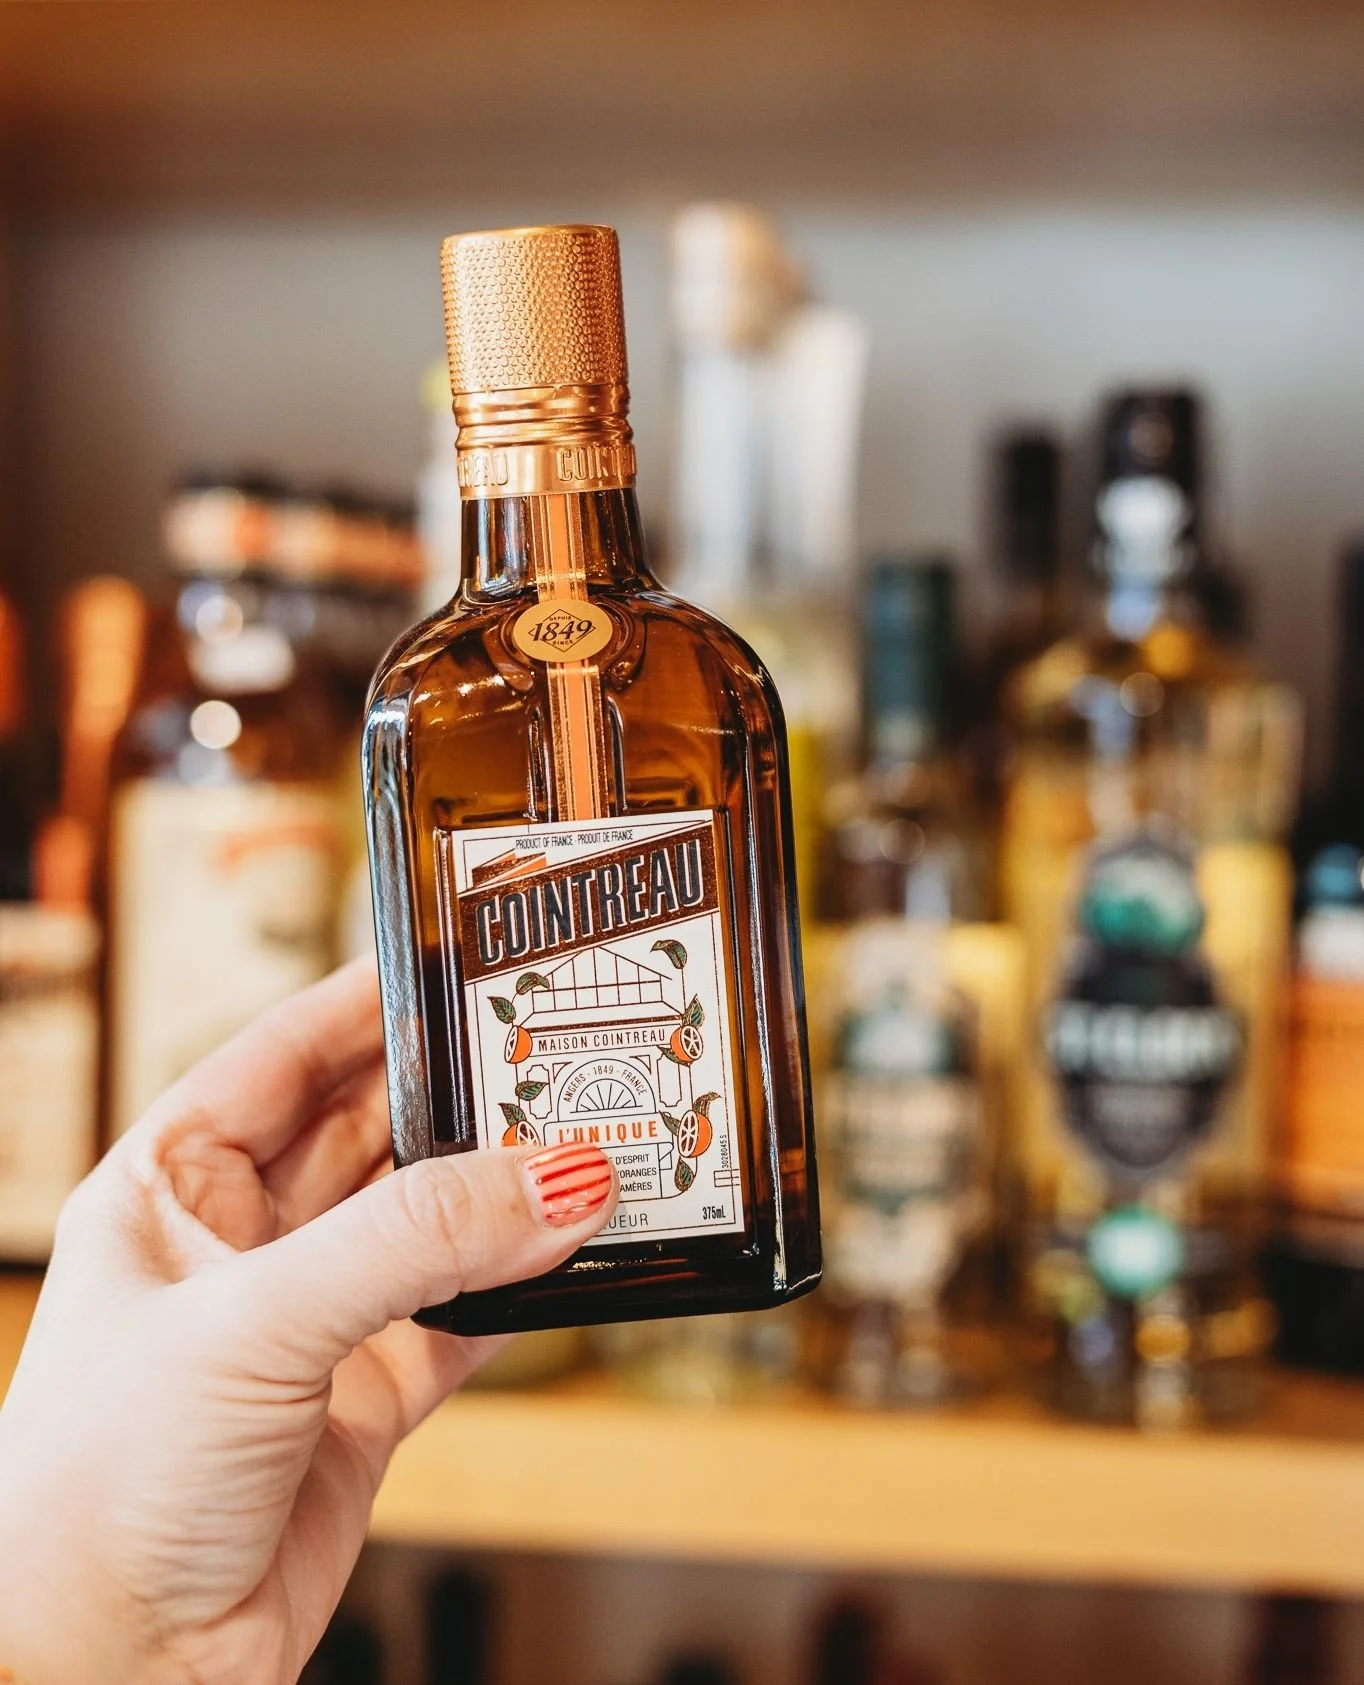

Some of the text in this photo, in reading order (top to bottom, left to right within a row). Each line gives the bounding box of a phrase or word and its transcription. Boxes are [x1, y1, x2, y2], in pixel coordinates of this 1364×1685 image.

[532, 619, 593, 641] 1849
[515, 829, 633, 850] PRODUCT OF FRANCE PRODUIT DE FRANCE
[476, 838, 704, 966] COINTREAU
[538, 1029, 666, 1052] MAISON COINTREAU
[563, 1064, 648, 1103] ANGERS 1849 FRANCE
[615, 1153, 650, 1166] D'ESPRIT
[617, 1167, 657, 1179] 'ORANGES
[619, 1180, 653, 1193] AMÈRES
[702, 1204, 726, 1221] 375mL
